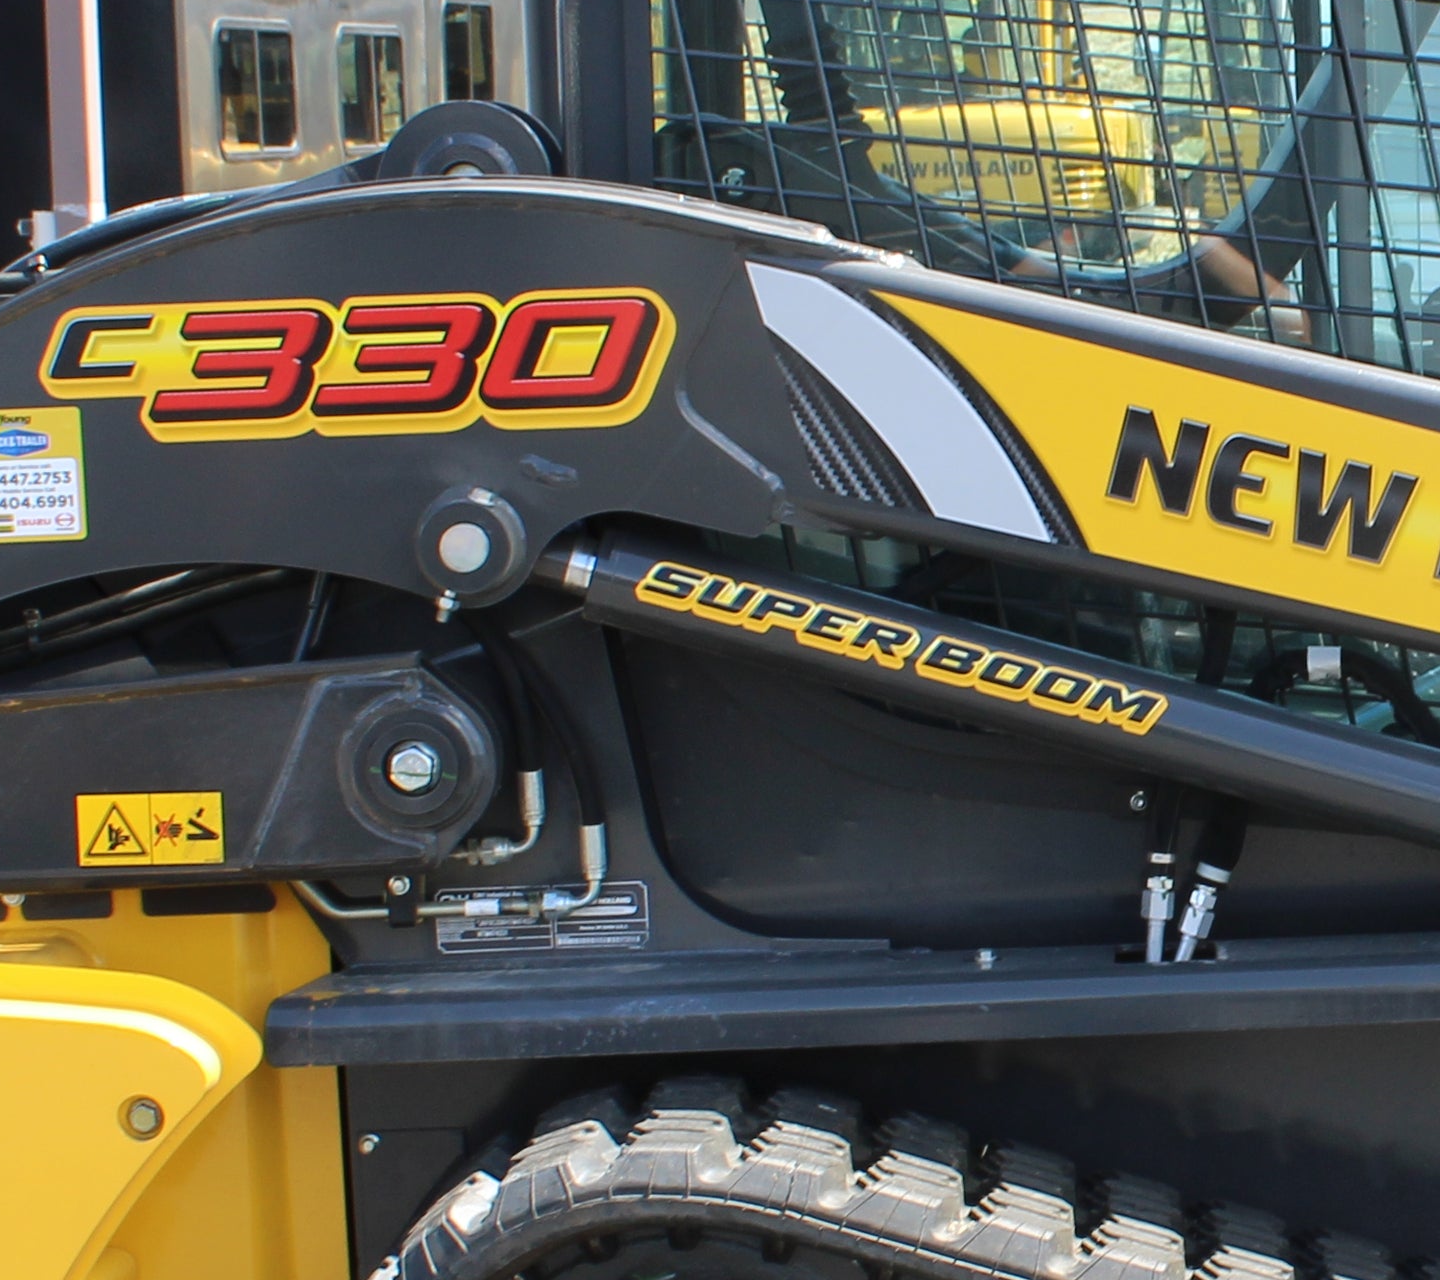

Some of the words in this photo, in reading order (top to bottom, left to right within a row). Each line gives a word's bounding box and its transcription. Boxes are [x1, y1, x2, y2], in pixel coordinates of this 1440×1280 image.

[44, 294, 665, 428] C330
[1106, 404, 1419, 563] NEW
[639, 563, 920, 666] SUPER
[918, 636, 1168, 731] BOOM
